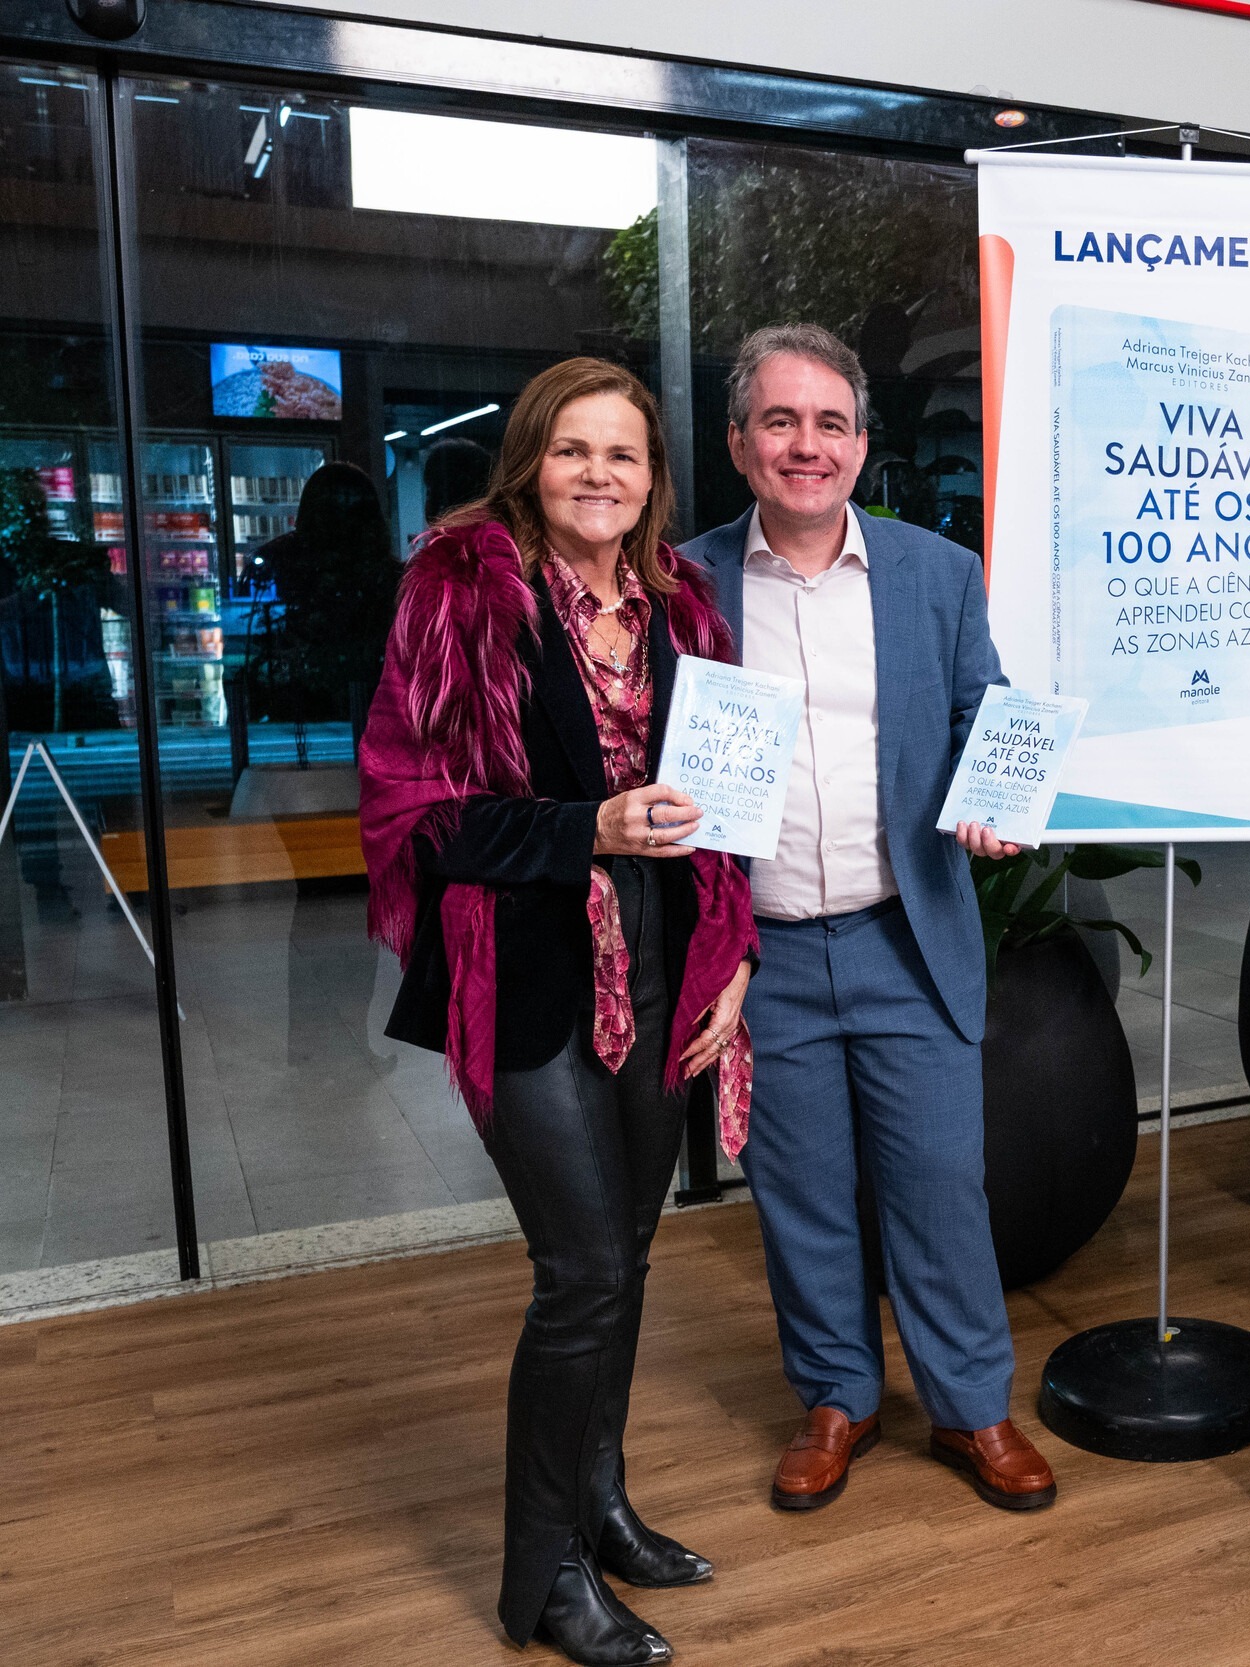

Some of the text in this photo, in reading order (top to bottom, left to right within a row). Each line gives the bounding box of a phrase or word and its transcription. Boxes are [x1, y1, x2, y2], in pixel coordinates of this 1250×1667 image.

[1122, 339, 1176, 358] Adriana
[1180, 346, 1223, 366] Trejger
[1126, 357, 1174, 375] Marcus
[1178, 363, 1224, 380] Vinicius
[1172, 377, 1230, 392] EDITORES
[1159, 402, 1243, 440] VIVA
[1054, 505, 1060, 519] OS
[1136, 482, 1200, 521] ATÉ
[1102, 531, 1172, 564] 100
[1107, 577, 1126, 598] O
[1134, 576, 1179, 597] QUE
[1186, 576, 1200, 595] A
[1116, 602, 1223, 626] APRENDEU
[1111, 636, 1139, 656] AS
[1147, 630, 1220, 654] ZONAS
[1180, 684, 1220, 699] manole
[719, 700, 759, 722] VIVA
[1010, 718, 1040, 733] VIVA
[982, 730, 1054, 751] SAUDÁVEL
[988, 747, 1039, 764] ATÉ OS
[681, 753, 775, 784] 100 ANOS
[971, 760, 1046, 781] 100 ANOS
[680, 774, 769, 798] O QUE A CIÊNCIA
[967, 787, 1031, 803] APRENDEU COM
[977, 777, 995, 787] QUE
[1005, 782, 1038, 793] CIÊNCIA
[681, 788, 763, 810] APRENDEU COM
[974, 799, 1004, 810] ZONAS
[1005, 804, 1029, 814] AZUIS
[733, 810, 763, 823] AZUIS
